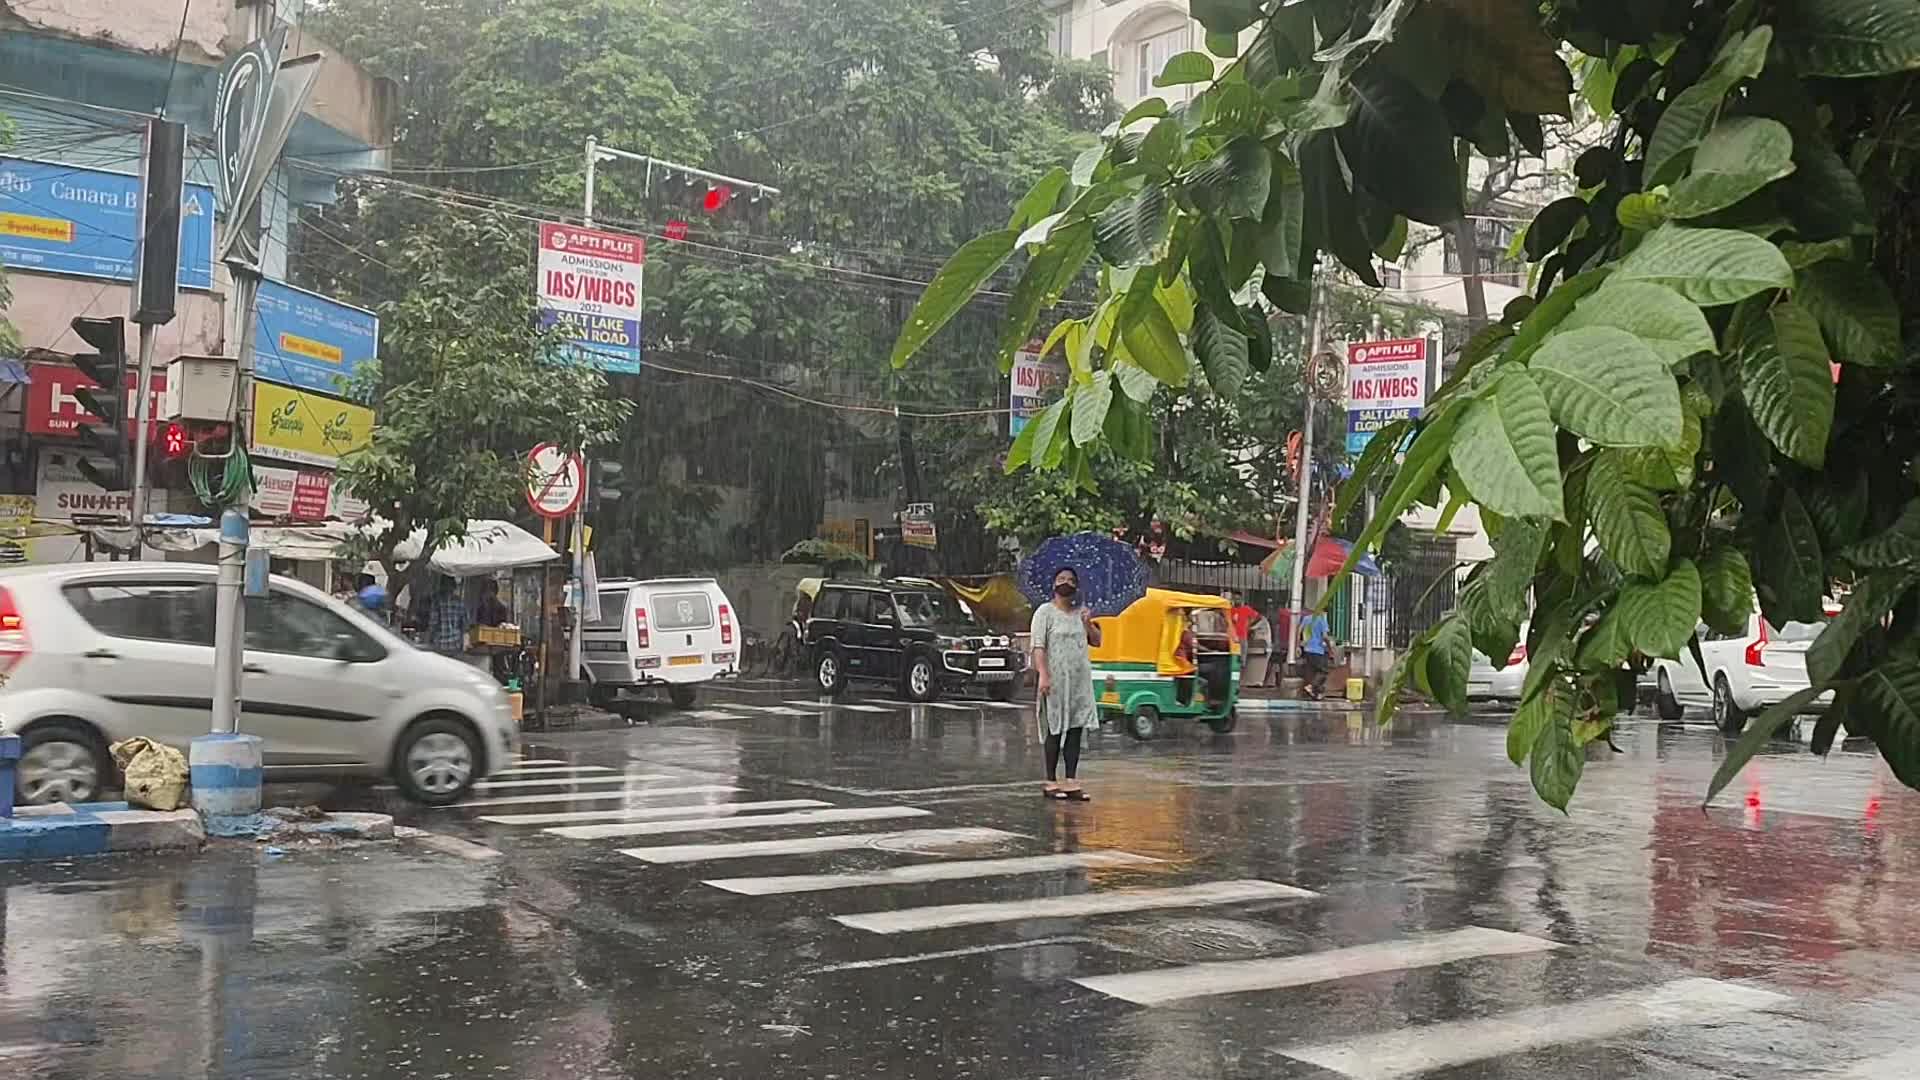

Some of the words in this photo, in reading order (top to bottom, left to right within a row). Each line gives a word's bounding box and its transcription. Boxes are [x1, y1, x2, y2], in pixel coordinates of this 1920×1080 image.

[51, 181, 119, 208] Canara
[568, 233, 600, 249] APTI
[602, 238, 633, 254] PLUS
[561, 254, 624, 273] ADMISSIONS
[546, 269, 635, 308] IAS/WBCS
[580, 303, 603, 314] 2022
[557, 311, 589, 328] SALT
[591, 316, 624, 332] LAKE
[591, 329, 630, 346] ROAD
[1367, 346, 1391, 356] APTI
[1392, 344, 1417, 354] PLUS
[1352, 376, 1418, 400] IAS/WBCS
[48, 418, 70, 429] SUN
[1359, 410, 1384, 421] SALT
[1384, 408, 1411, 420] LAKE
